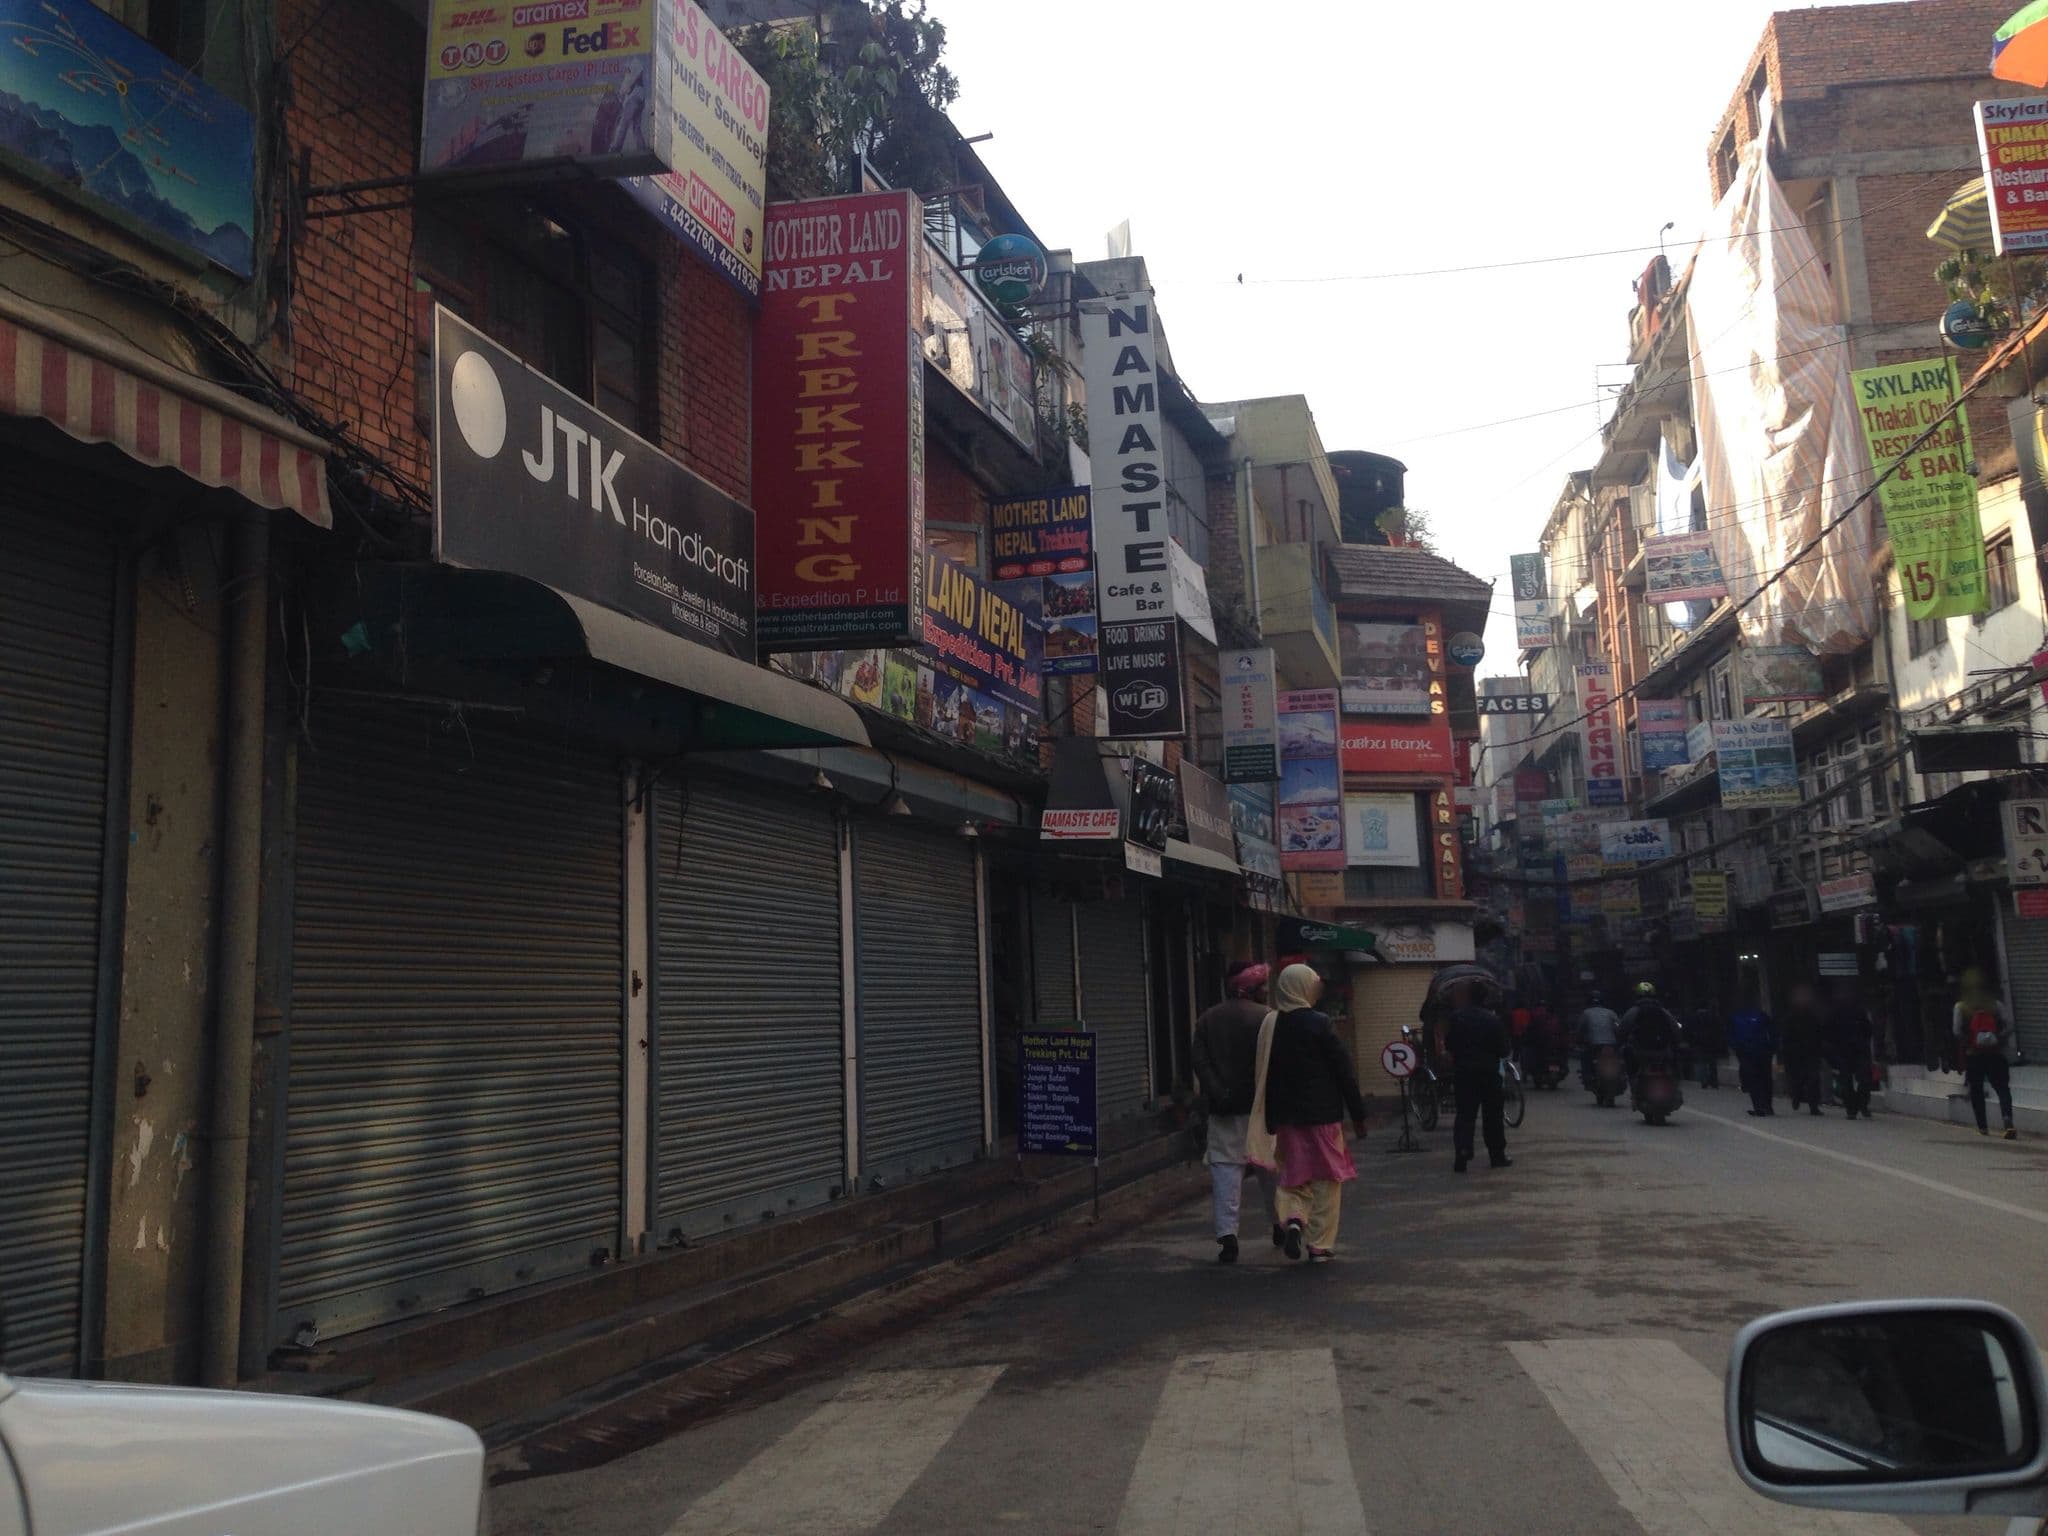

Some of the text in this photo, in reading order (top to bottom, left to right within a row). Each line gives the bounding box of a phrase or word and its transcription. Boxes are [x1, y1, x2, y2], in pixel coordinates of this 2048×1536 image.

[513, 1, 587, 25] aramex
[563, 21, 640, 55] FedEx
[444, 43, 503, 65] TNT
[704, 28, 766, 133] CARGO
[690, 177, 736, 243] aramex
[2007, 190, 2019, 204] &
[849, 208, 902, 254] LAND
[719, 248, 759, 297] 4421936
[766, 259, 894, 292] NEPAL
[1863, 366, 1950, 400] SKYLARK
[1863, 402, 1919, 433] Thakali
[795, 293, 863, 584] TREKKING
[1107, 304, 1168, 574] NAMASTE
[521, 404, 627, 527] JTK
[1898, 461, 1914, 482] &
[993, 495, 1088, 529] MOTHER LAND
[632, 496, 750, 591] Handicraft
[994, 526, 1089, 558] NEPAL Trekking
[772, 590, 850, 611] Expedition
[1108, 581, 1163, 598] Cafe &
[1136, 599, 1165, 611] Bar
[927, 554, 1026, 661] LAND NEPAL
[1105, 624, 1167, 645] FOOD DRINKS
[1107, 652, 1167, 671] LIVE MUSIC
[1425, 622, 1445, 715] DEVAS
[1577, 665, 1611, 678] HOTEL
[1477, 696, 1544, 713] FACES
[1043, 811, 1118, 827] NAMASTE CAFE
[1025, 1048, 1057, 1061] Trekking
[1050, 1036, 1068, 1046] Land
